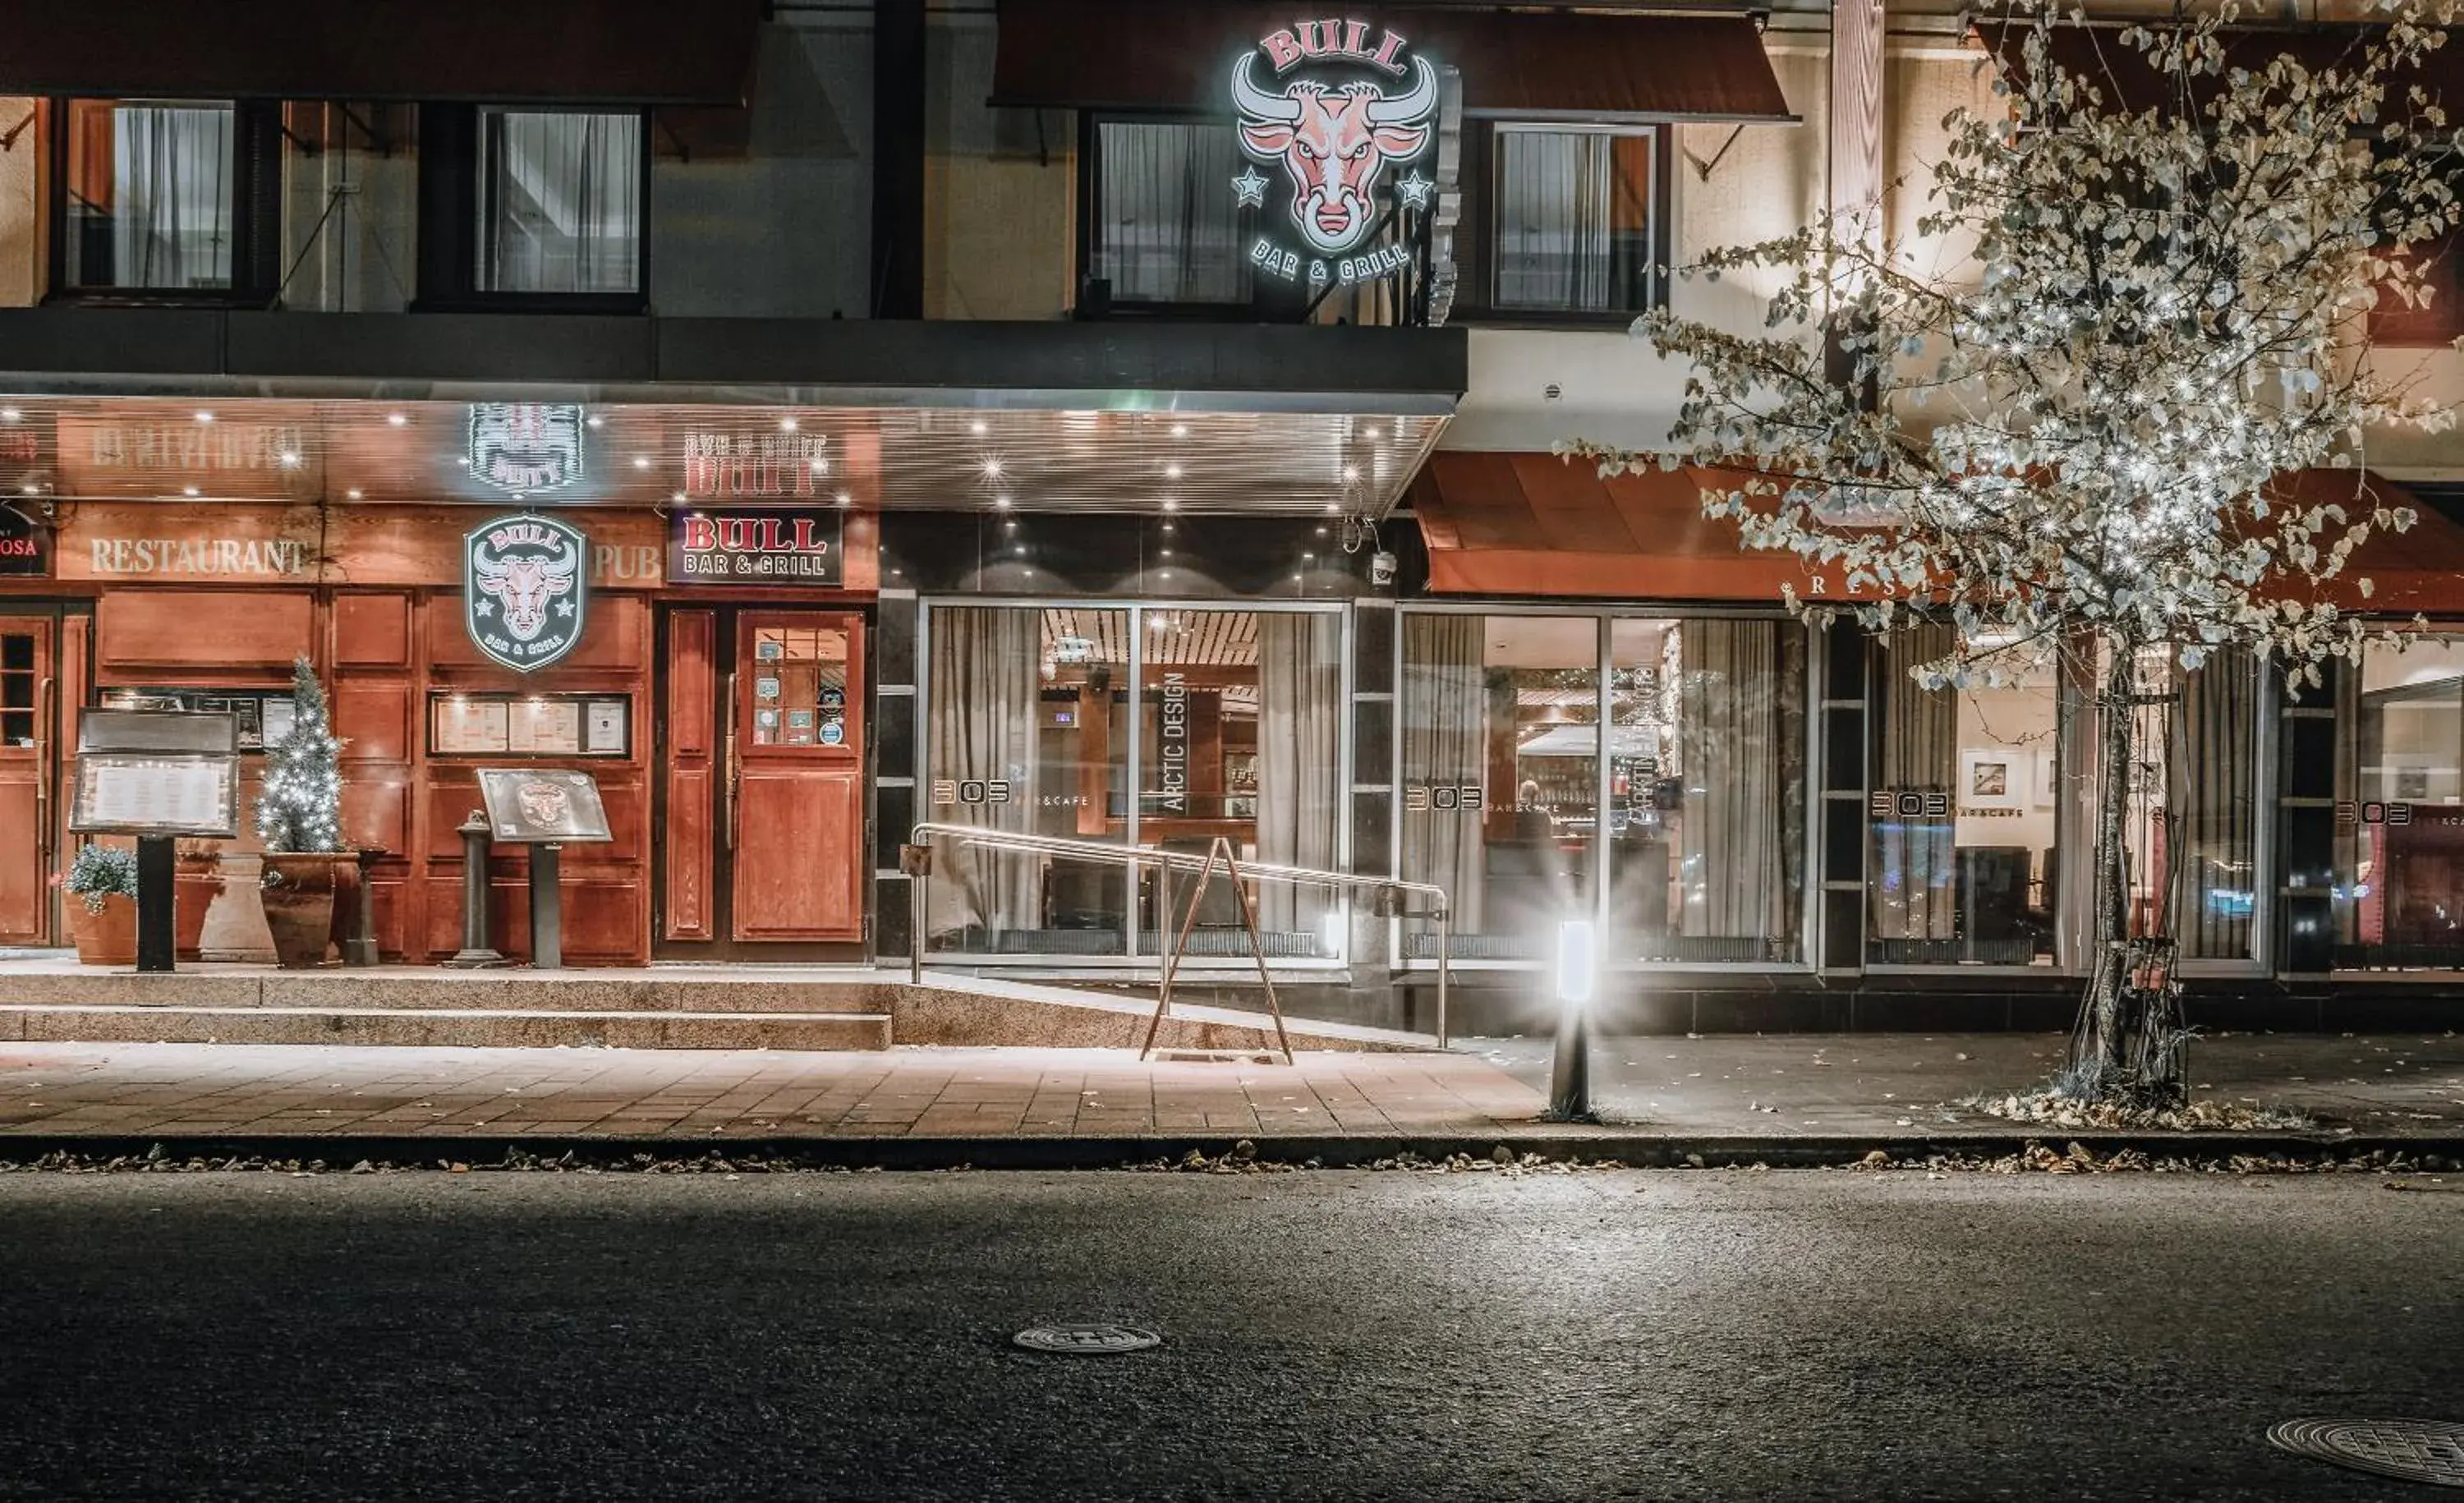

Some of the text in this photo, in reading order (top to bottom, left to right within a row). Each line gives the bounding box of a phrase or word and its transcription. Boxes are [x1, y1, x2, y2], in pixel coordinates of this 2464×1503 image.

[1260, 19, 1408, 76] BULL
[1252, 240, 1410, 280] BAR & GRILL
[0, 539, 37, 555] OSA
[487, 523, 563, 553] BULL
[683, 513, 827, 554] BULL
[90, 537, 309, 574] RESTAURANT
[594, 545, 662, 579] PUB
[683, 554, 825, 576] BAR & GRILL
[485, 633, 509, 653] BAR
[527, 635, 564, 655] GRILL
[1163, 672, 1185, 811] ARCTIC DESIGN
[934, 779, 1012, 805] 303
[1407, 785, 1483, 811] 303
[1872, 791, 1948, 818] 303
[2337, 800, 2412, 826] 303
